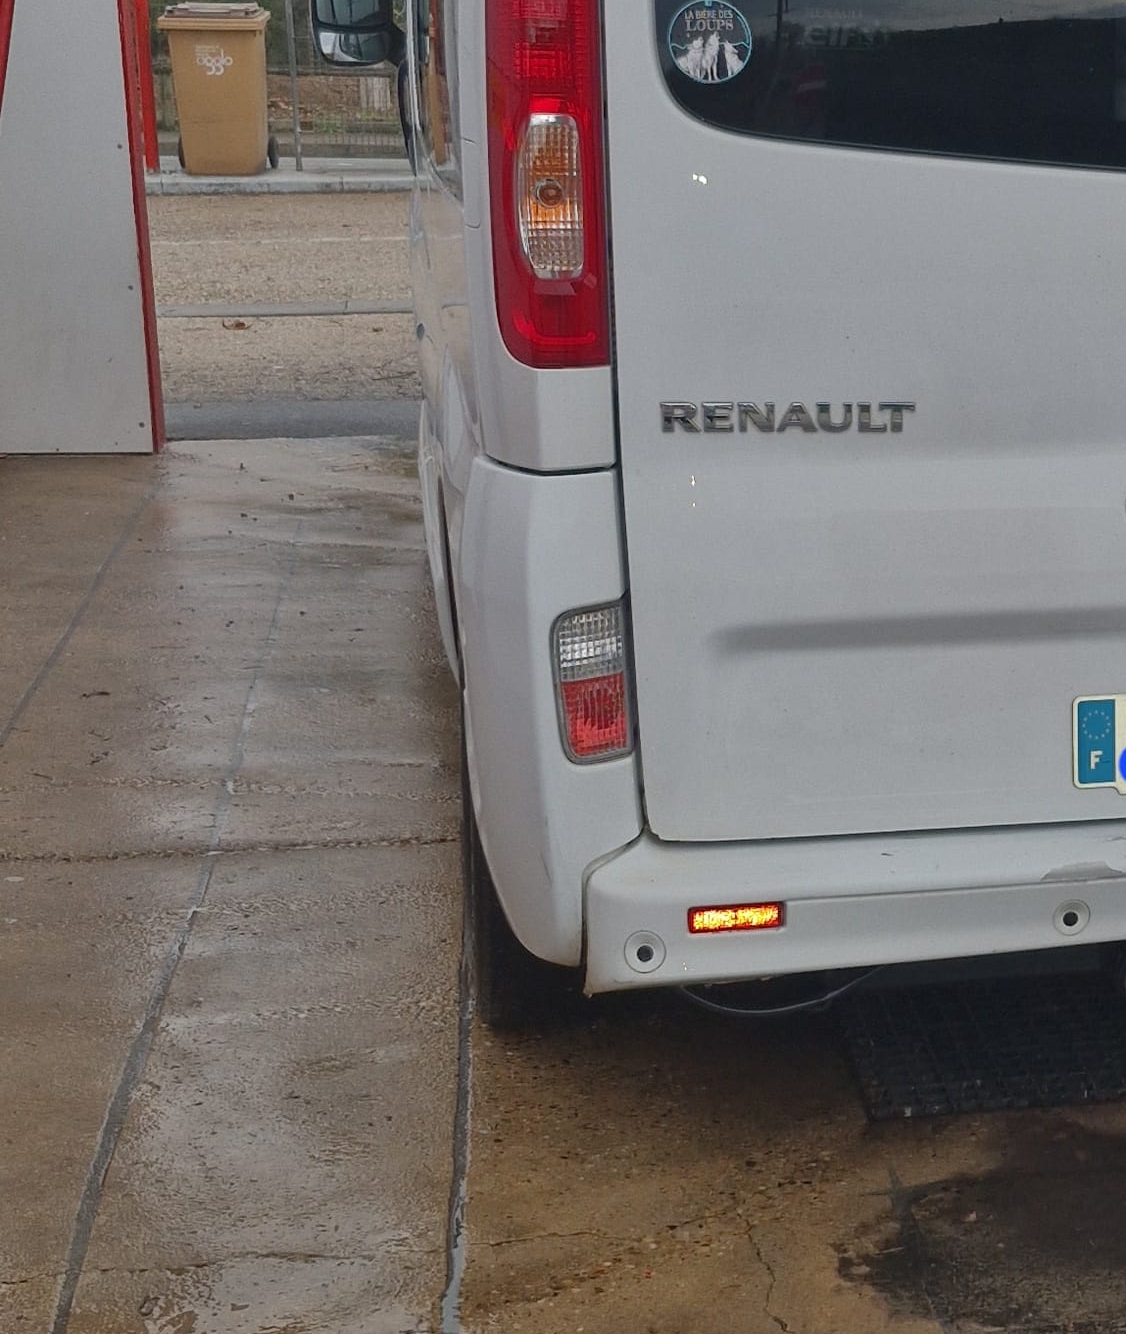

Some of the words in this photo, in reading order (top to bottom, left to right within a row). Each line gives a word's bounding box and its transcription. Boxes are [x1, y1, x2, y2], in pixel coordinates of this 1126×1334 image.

[684, 10, 695, 20] LA
[718, 9, 734, 19] DES
[685, 19, 734, 32] LOUPS
[659, 401, 917, 434] RENAULT
[1090, 750, 1104, 770] F
